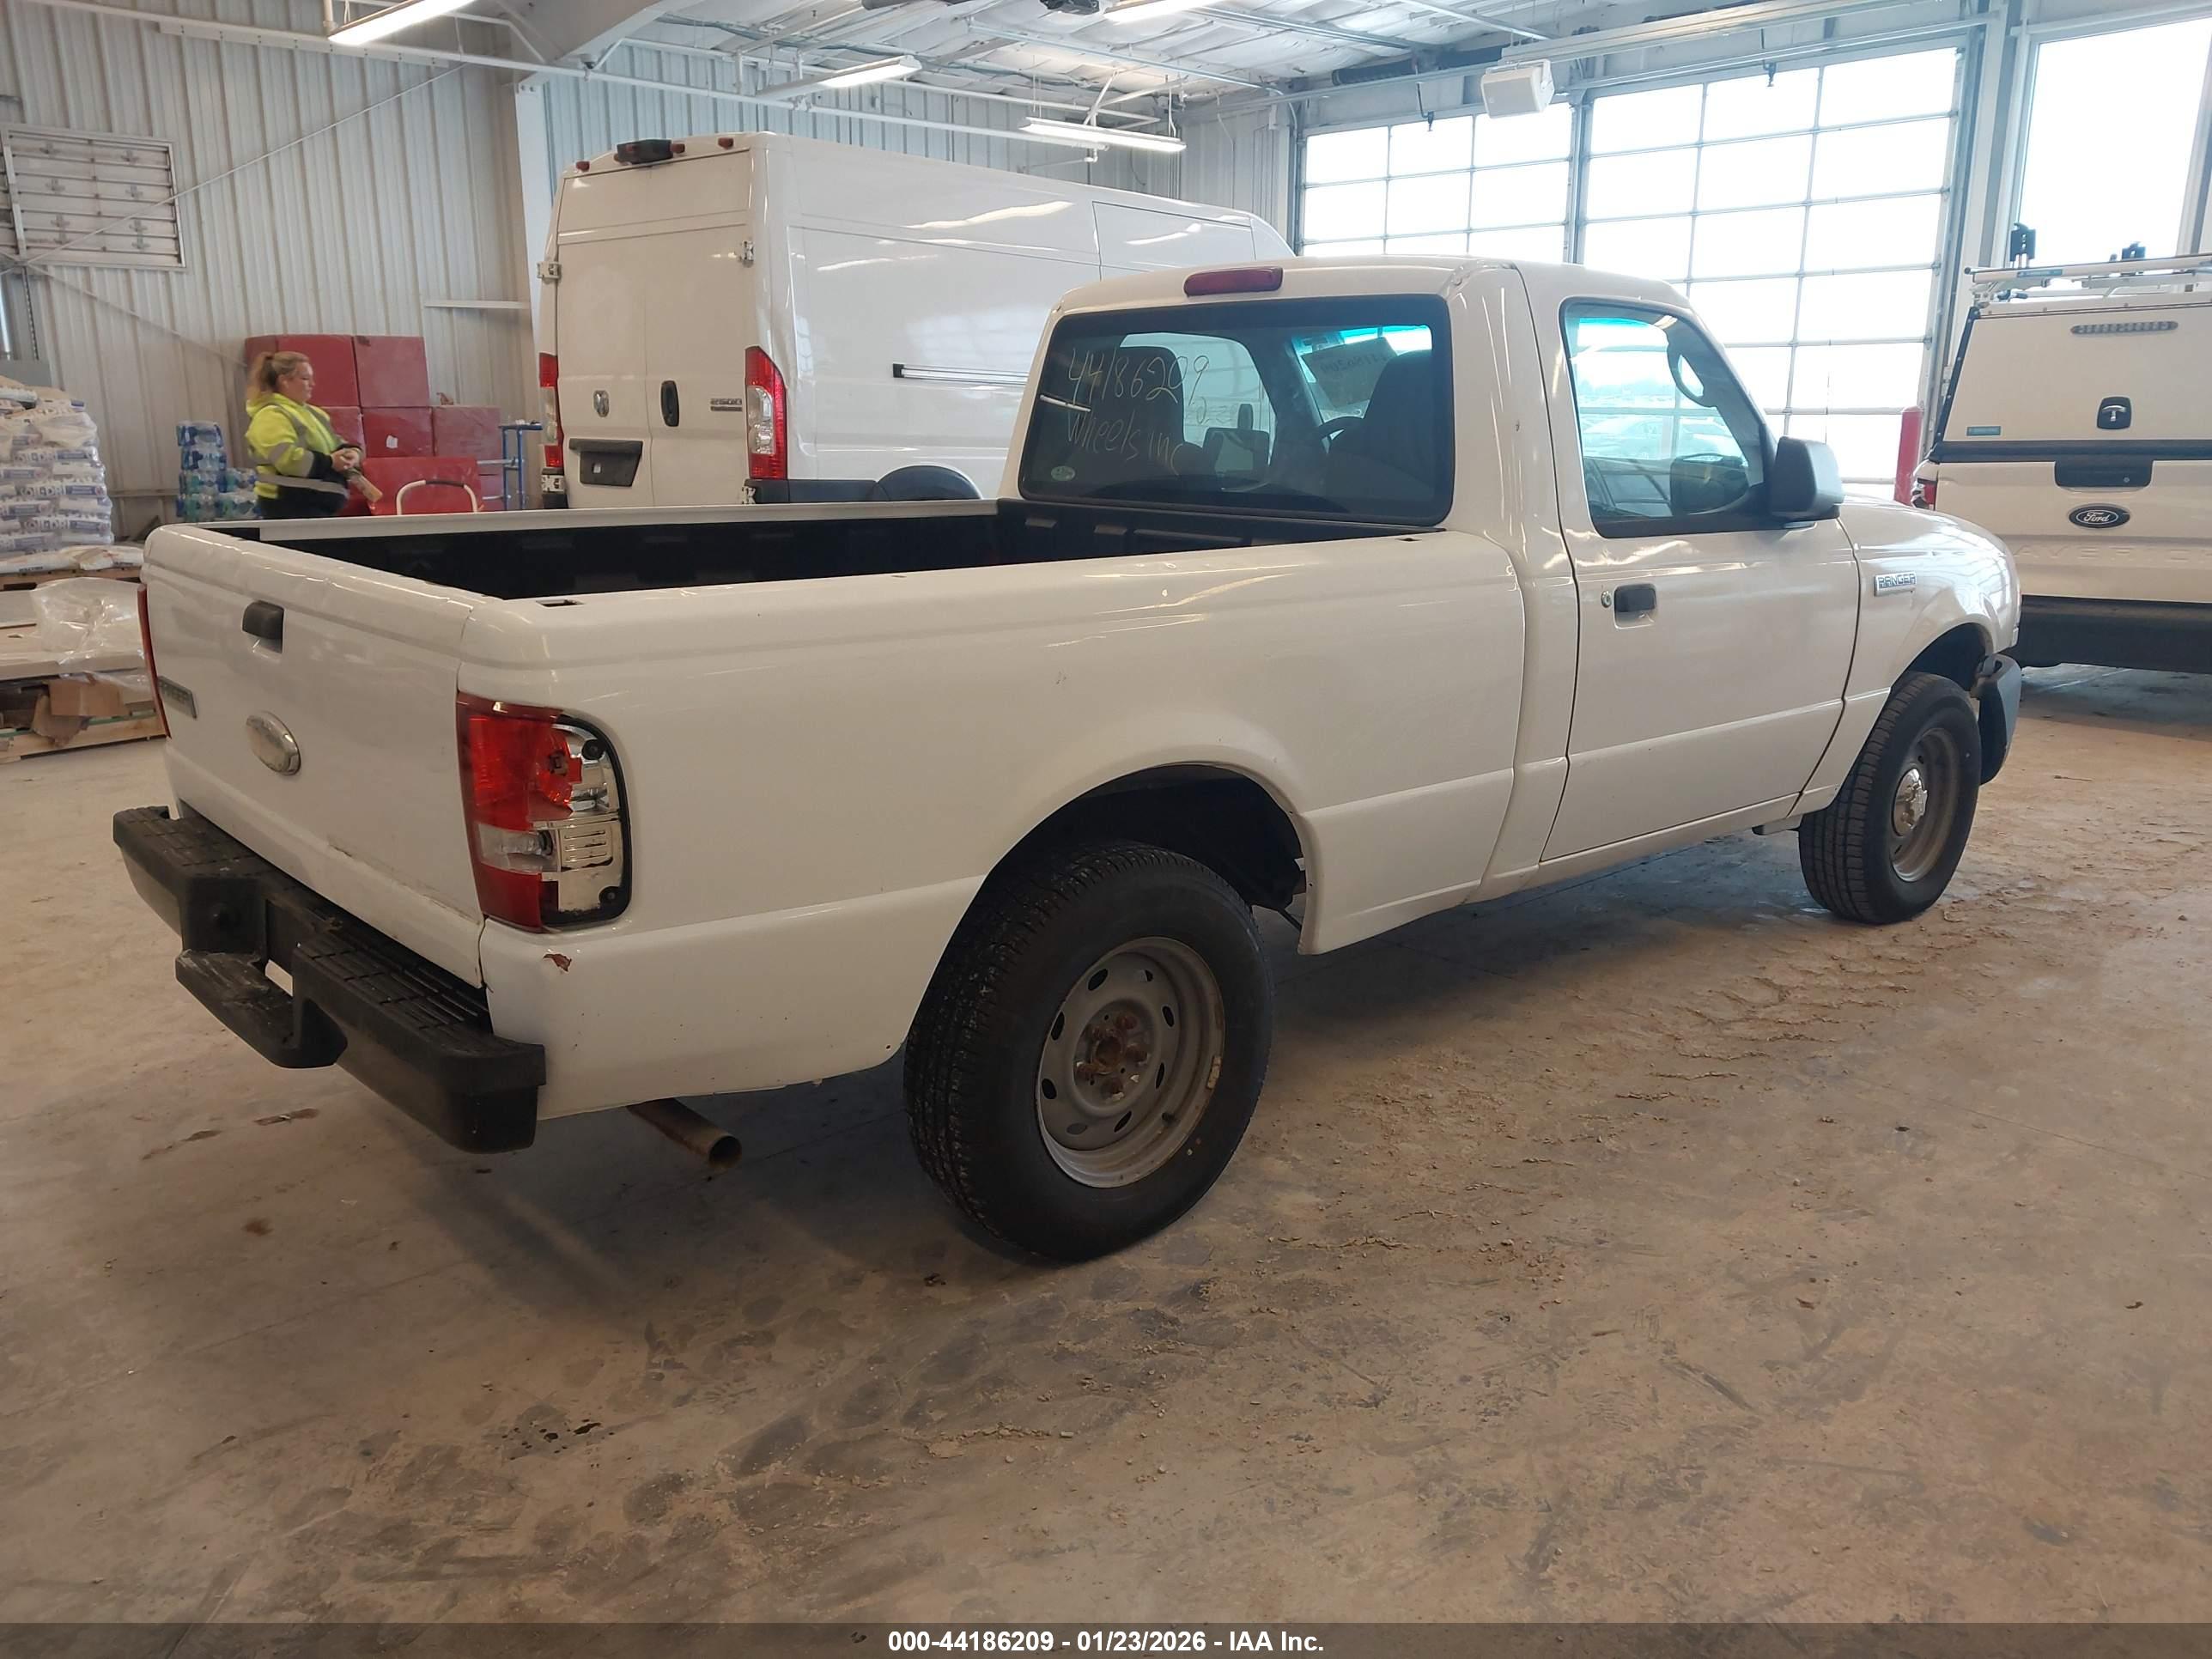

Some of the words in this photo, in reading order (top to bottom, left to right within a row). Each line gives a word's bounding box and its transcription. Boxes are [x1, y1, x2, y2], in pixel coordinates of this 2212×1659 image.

[1068, 348, 1209, 405] 44186209
[2084, 512, 2111, 522] Ford
[1877, 573, 1916, 589] RANGER
